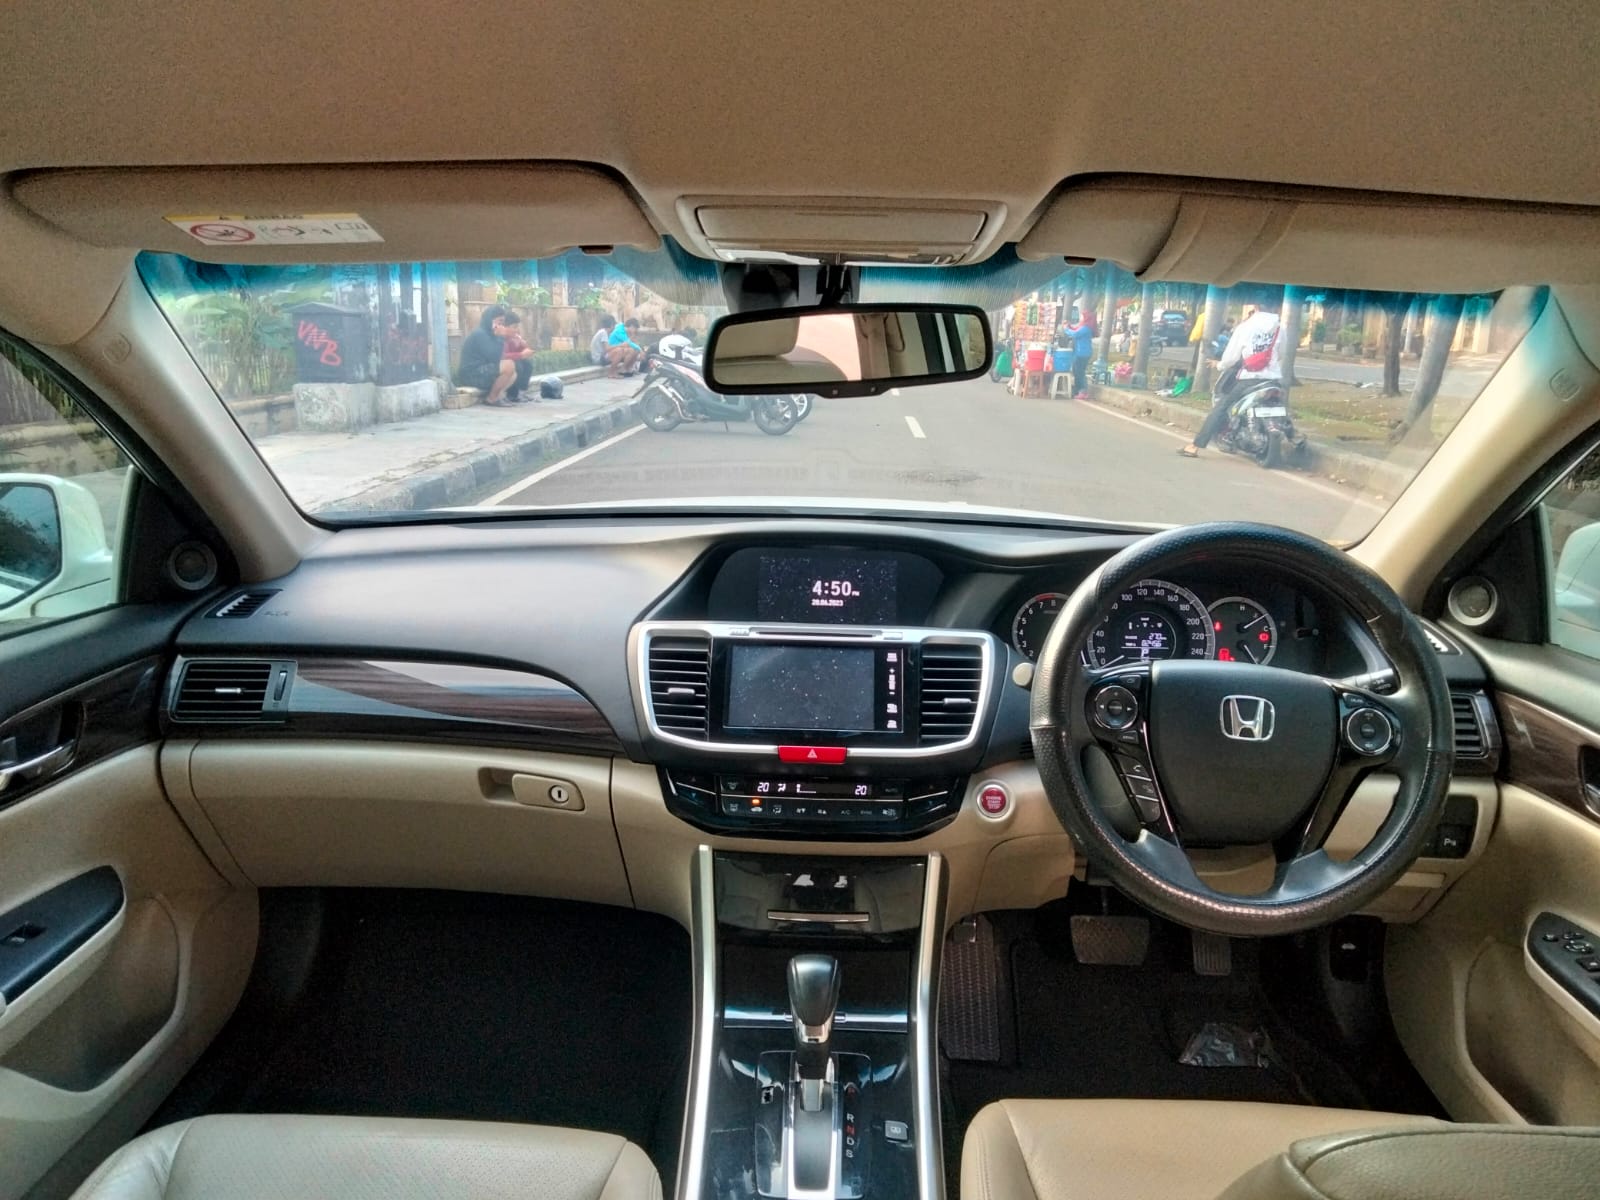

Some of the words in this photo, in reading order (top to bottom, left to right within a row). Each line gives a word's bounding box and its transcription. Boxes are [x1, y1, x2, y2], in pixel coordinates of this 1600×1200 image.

[812, 580, 851, 596] 4:50
[757, 782, 770, 792] 20
[855, 785, 867, 795] 20
[847, 1113, 854, 1122] R
[847, 1137, 854, 1145] D
